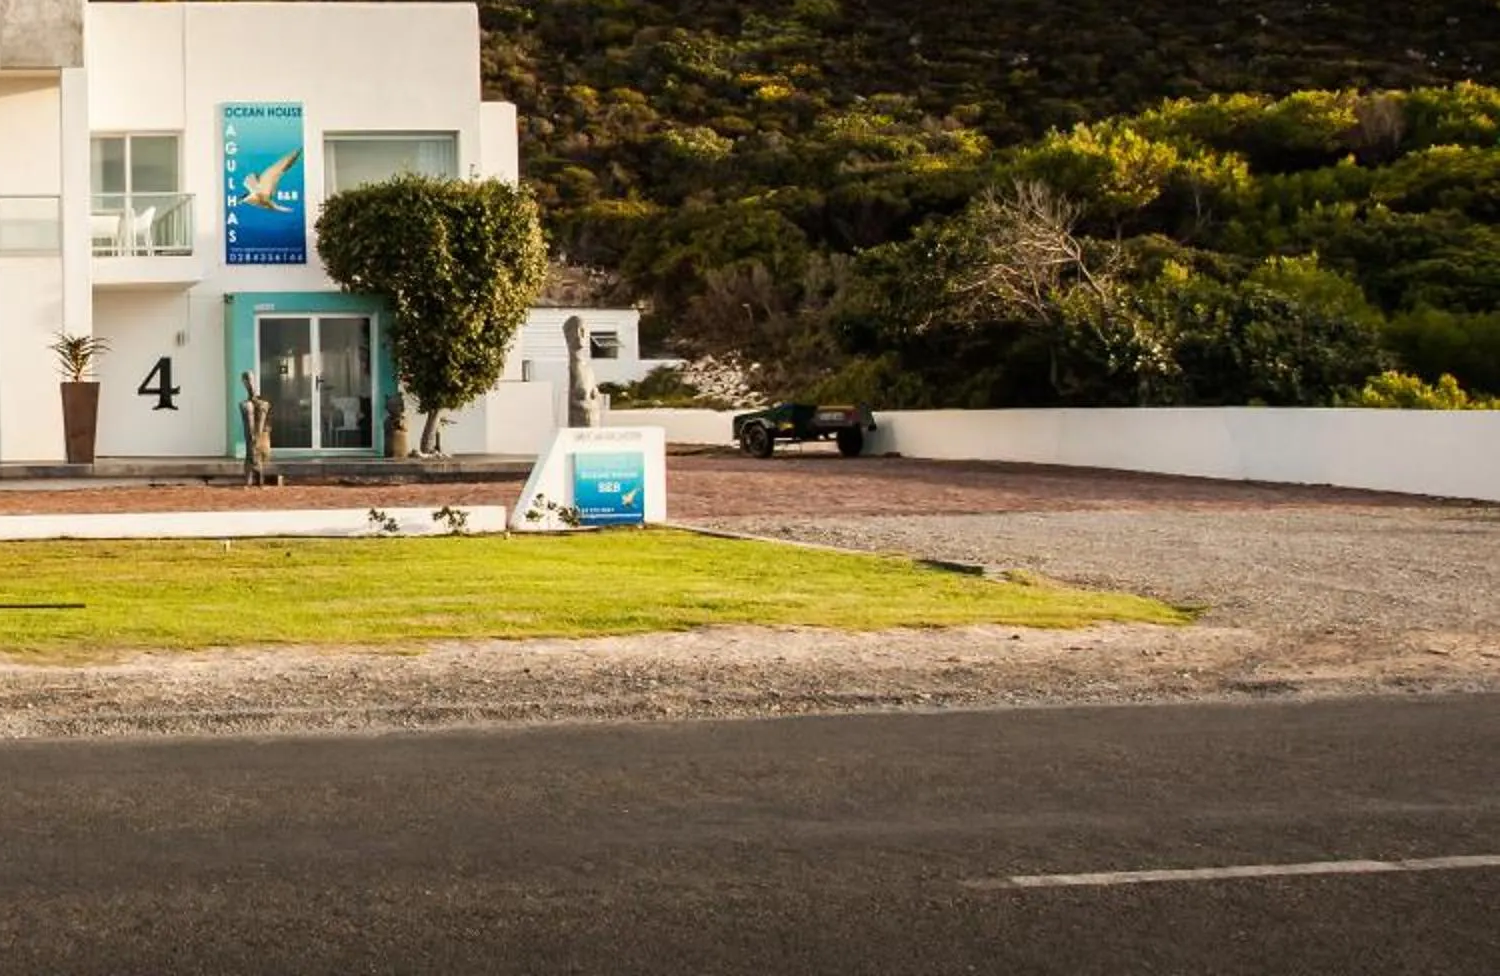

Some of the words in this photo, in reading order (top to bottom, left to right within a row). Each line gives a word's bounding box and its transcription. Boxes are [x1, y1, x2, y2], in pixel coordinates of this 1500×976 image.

[225, 107, 264, 117] OCEAN
[267, 107, 302, 117] HOUSE
[225, 125, 238, 243] AGULHAS
[277, 190, 298, 201] B&B
[137, 356, 181, 411] 4
